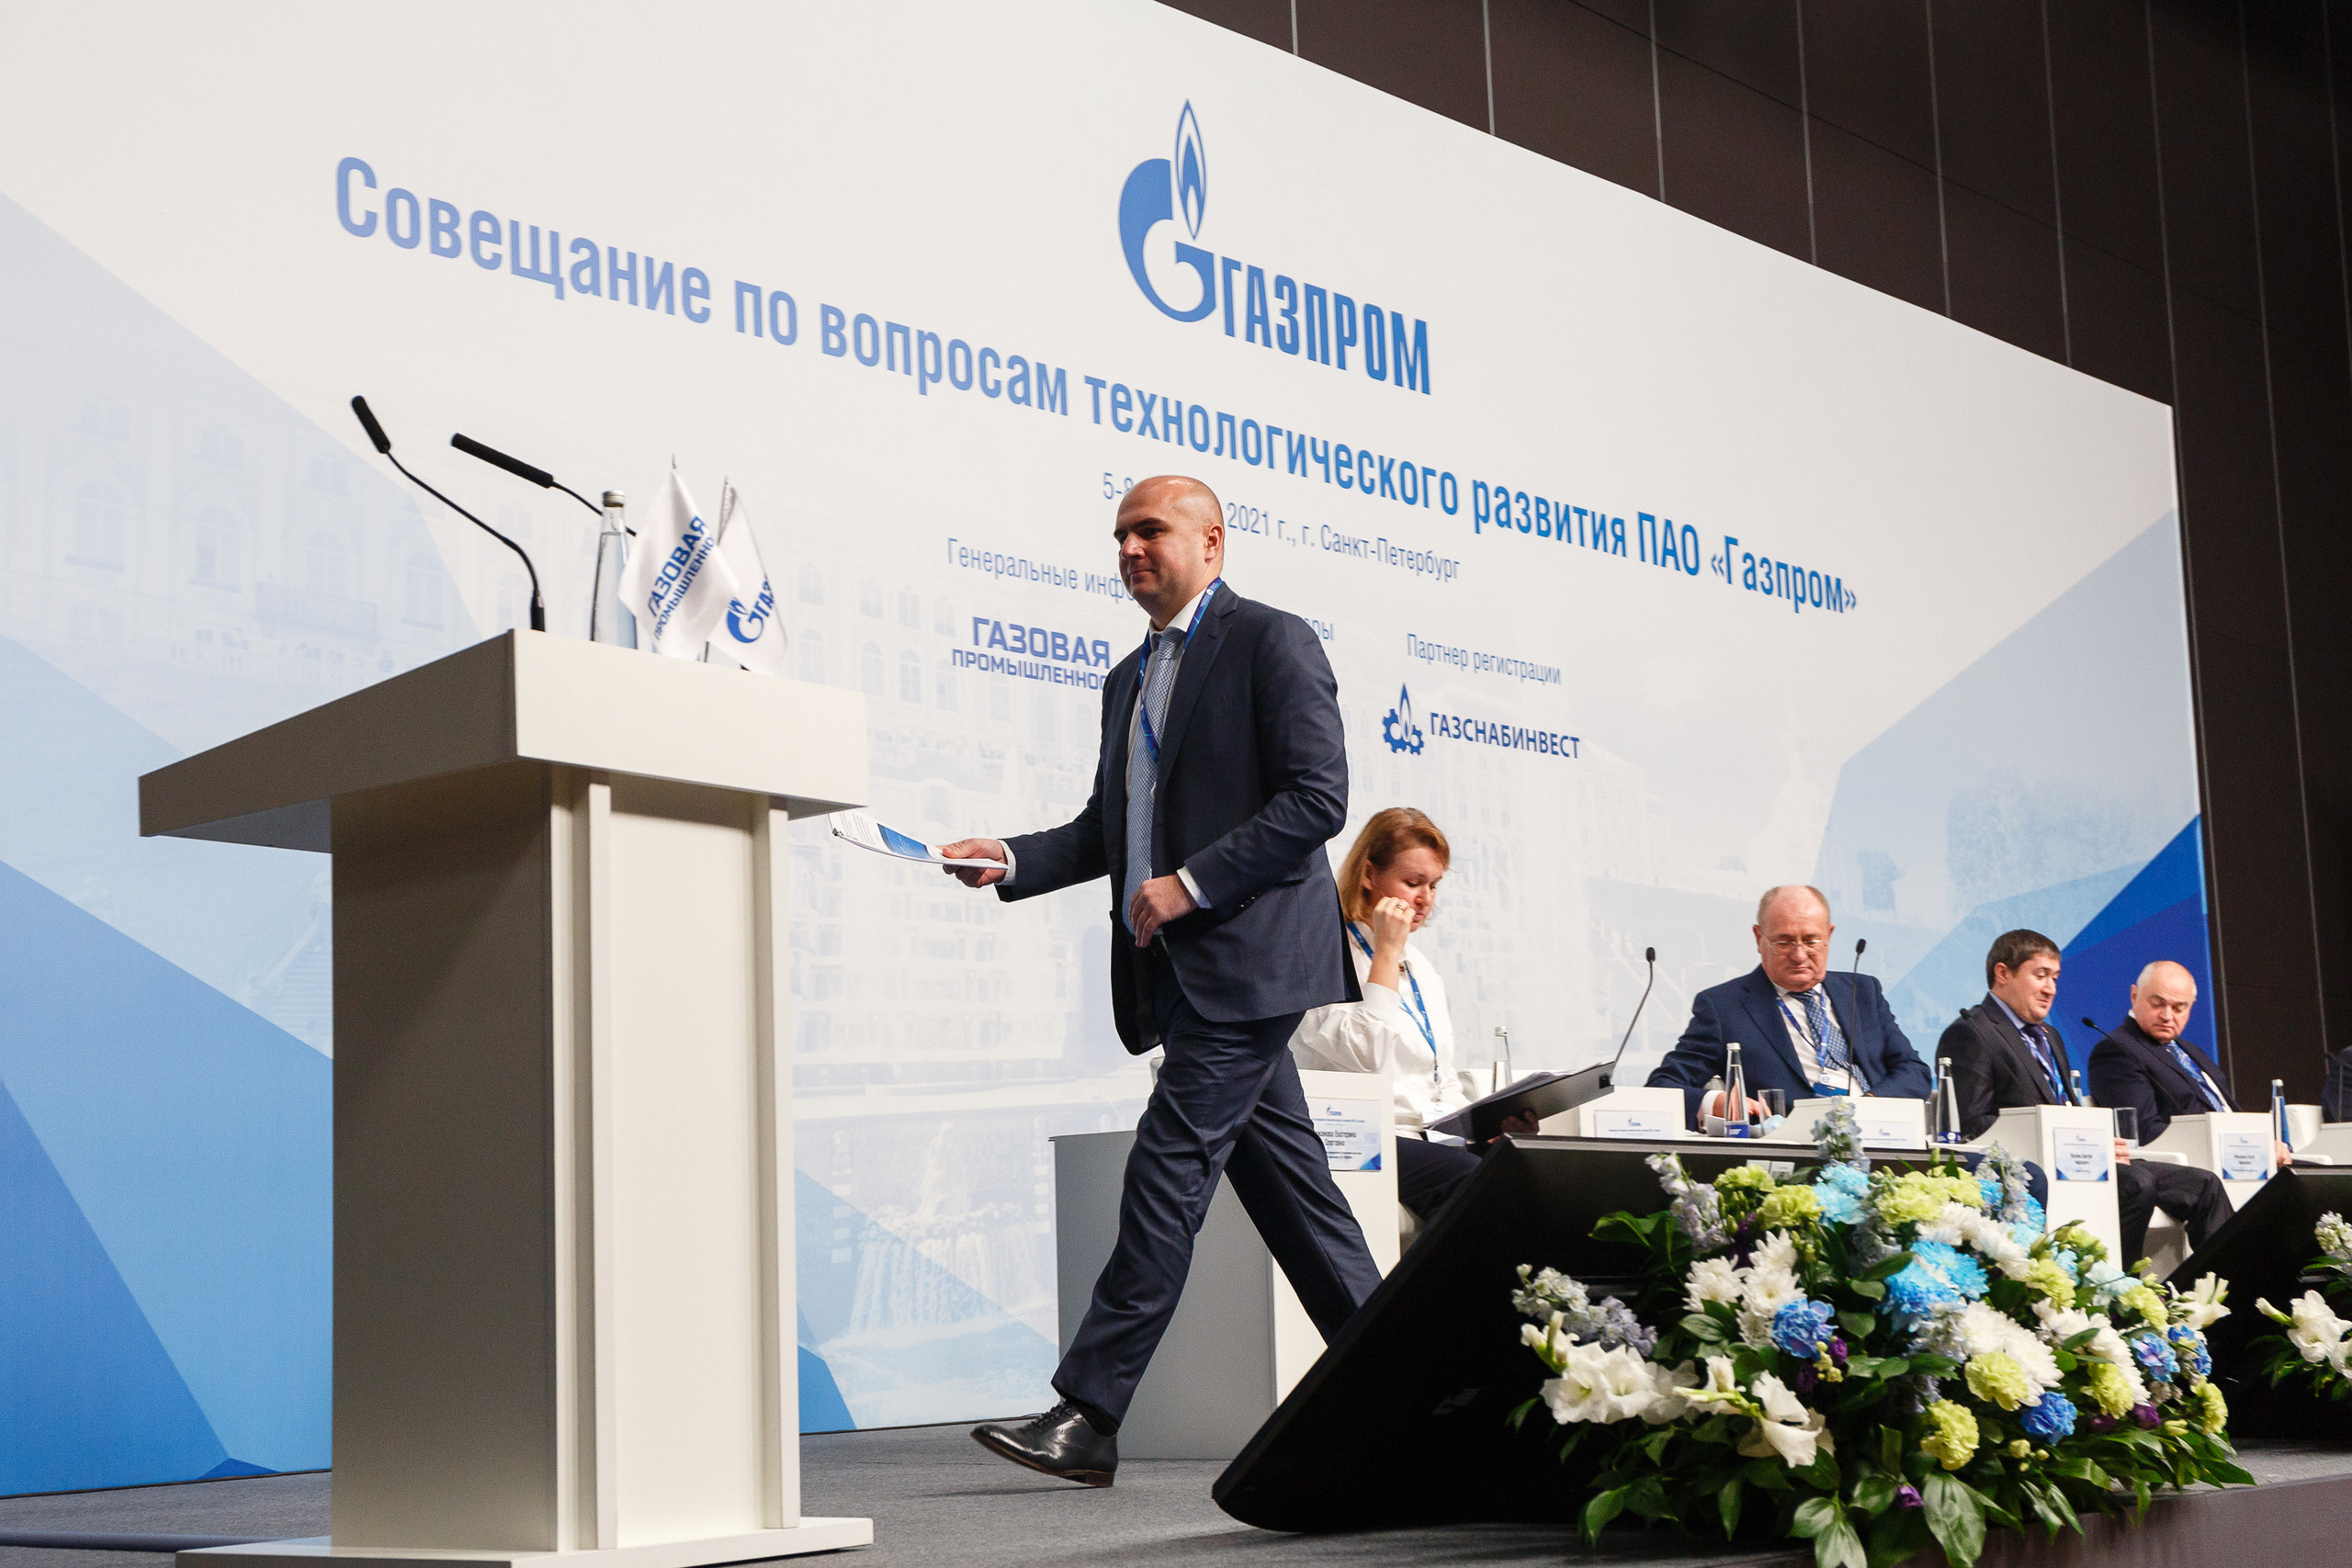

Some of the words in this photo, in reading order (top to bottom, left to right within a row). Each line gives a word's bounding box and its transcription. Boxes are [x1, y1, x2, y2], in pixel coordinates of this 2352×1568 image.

[1220, 255, 1431, 397] ГАЗПРОМ
[335, 156, 712, 324] Совещание
[734, 280, 798, 346] по
[820, 302, 1069, 417] вопросам
[1082, 374, 1460, 516] технологического
[1471, 479, 1628, 558] развития
[1636, 510, 1702, 577] ПАО
[1710, 534, 1858, 615] «Газпром»
[647, 515, 707, 617] ГАЗОВАЯ
[947, 536, 1078, 590] Генеральные
[1227, 502, 1270, 536] 2021
[1277, 519, 1297, 547] г.,
[1302, 525, 1316, 547] г.
[1320, 524, 1461, 582] Санкт-Петербург
[972, 616, 1111, 670] ГАЗОВАЯ
[1407, 632, 1468, 671] Партнер
[1473, 650, 1562, 685] регистрации
[1430, 712, 1580, 759] ГАЗСНАБИНВЕСТ
